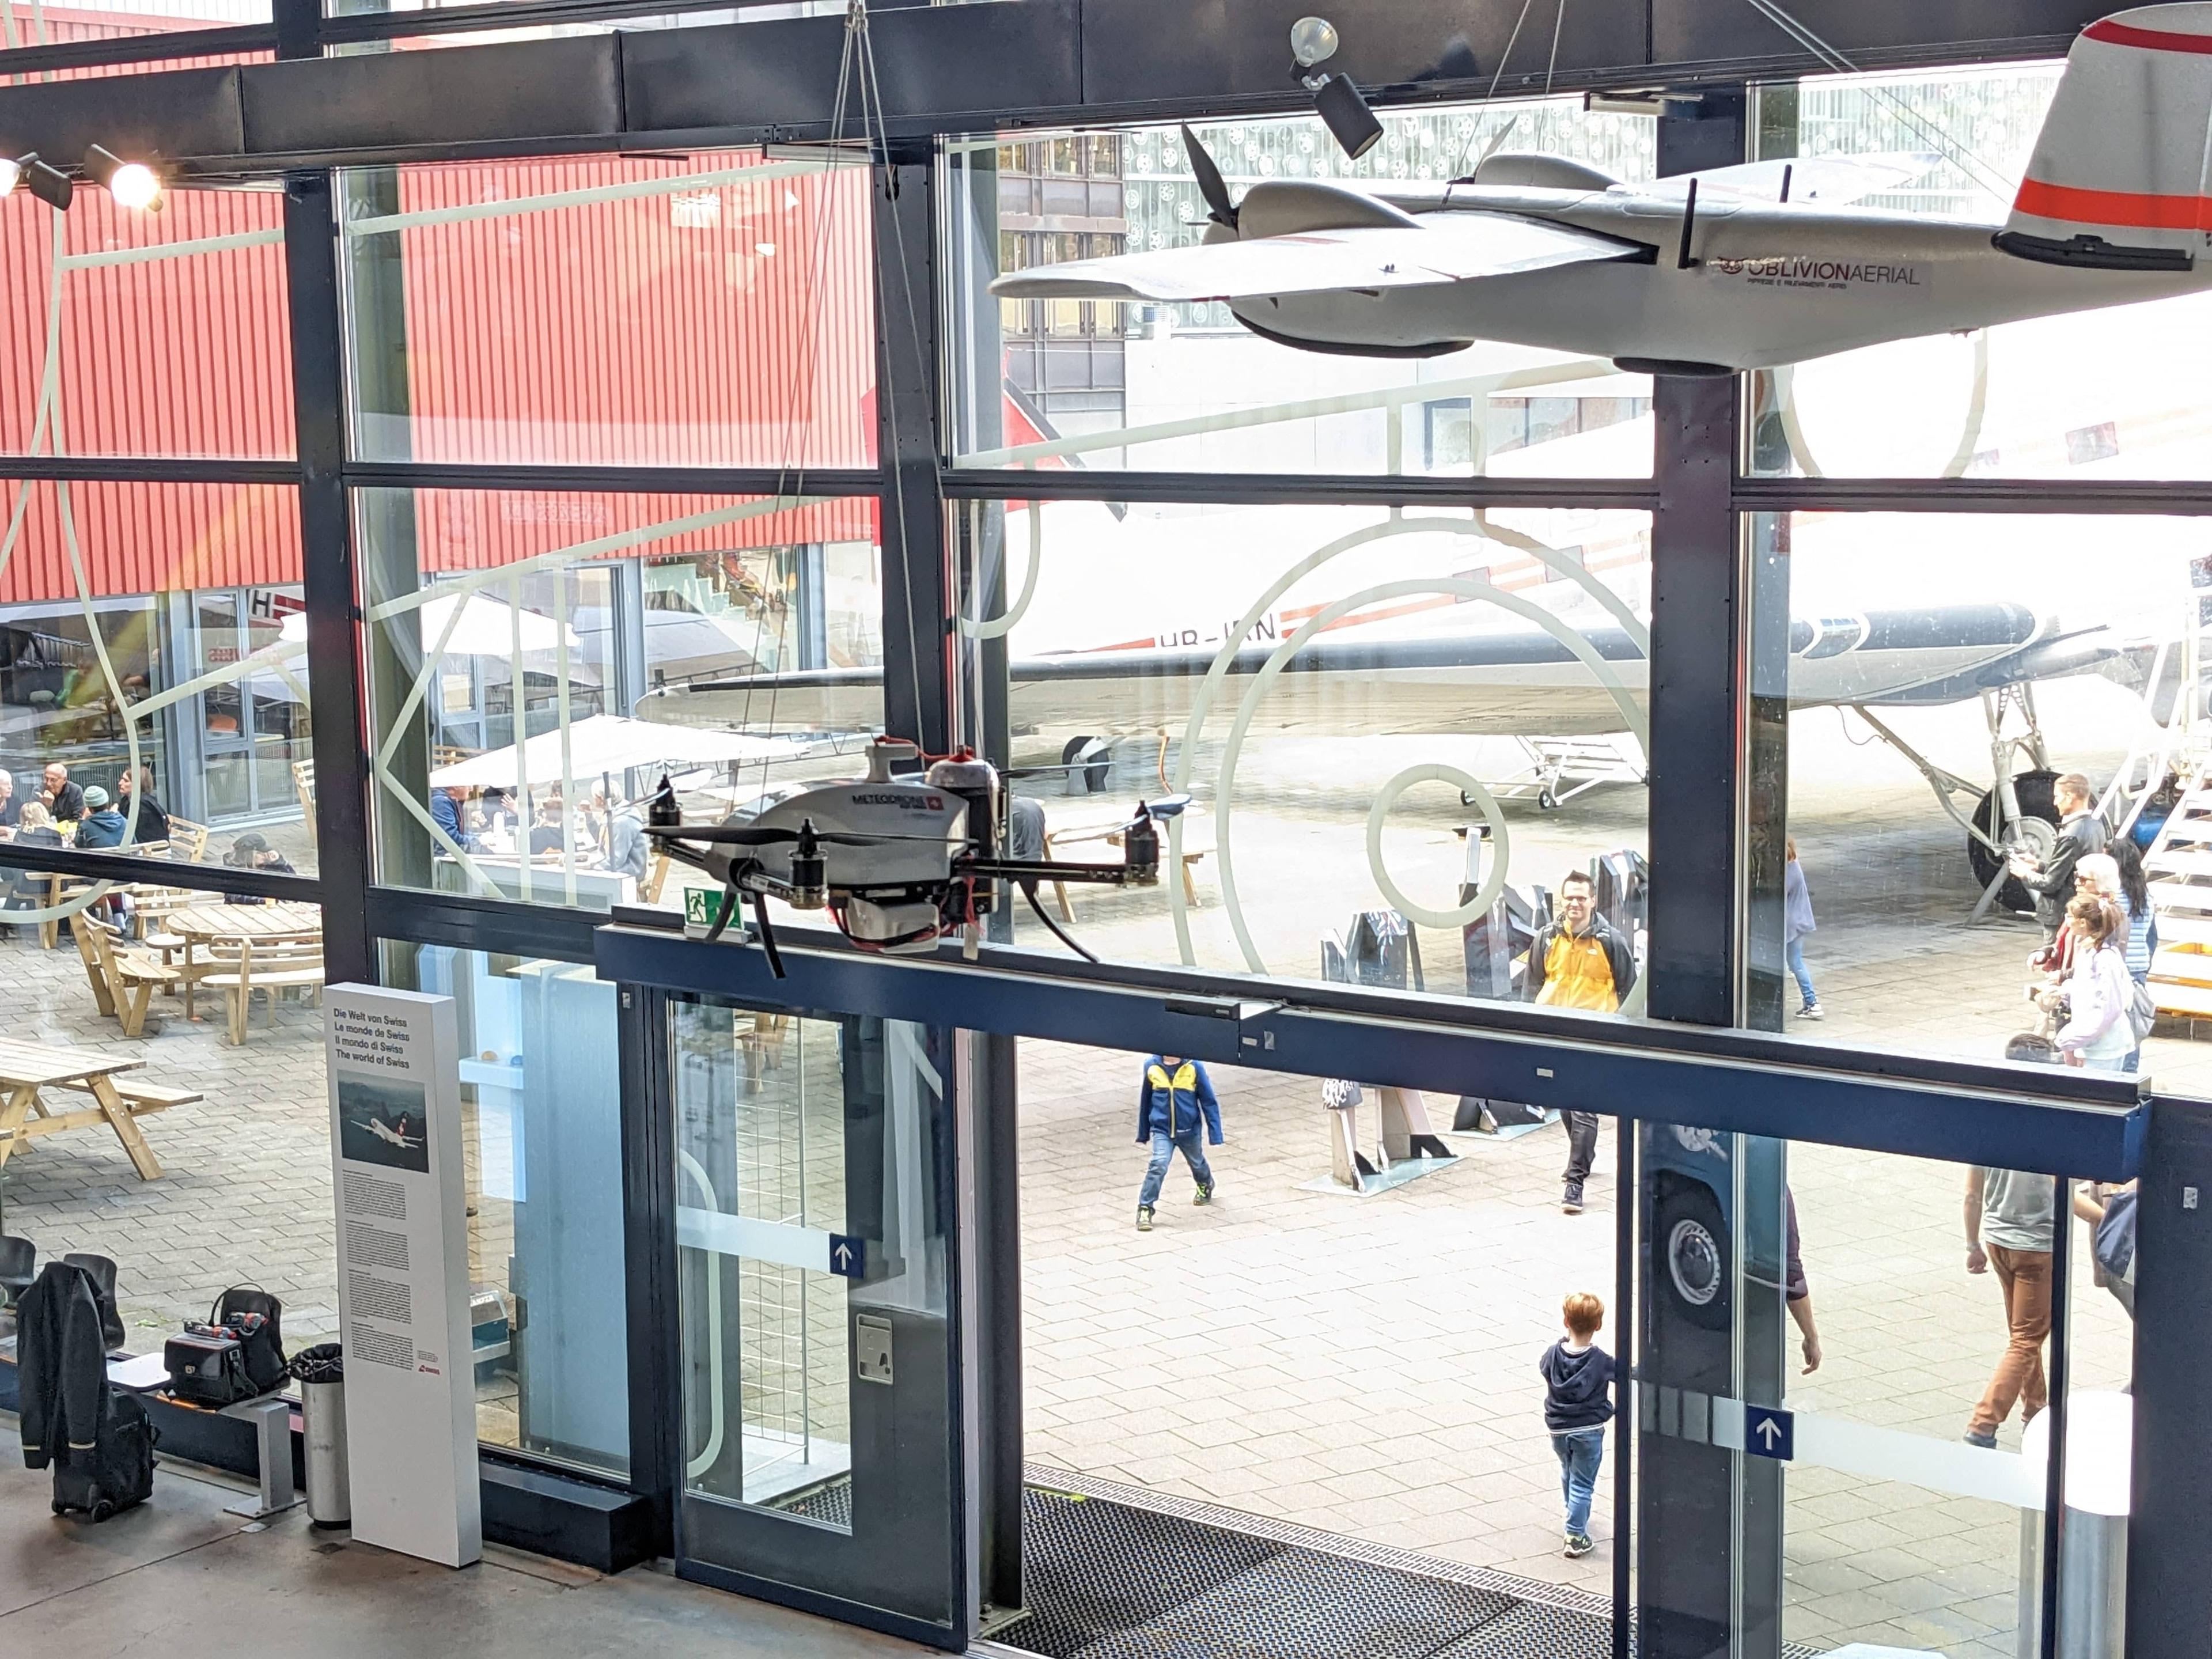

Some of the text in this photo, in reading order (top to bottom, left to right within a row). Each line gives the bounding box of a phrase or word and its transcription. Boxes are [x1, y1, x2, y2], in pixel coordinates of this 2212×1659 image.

[1748, 260, 1920, 285] OBLIVIONAERIAL
[334, 1008, 407, 1027] Die Welt von Swiss
[334, 1021, 410, 1041] Le monde de Swiss
[335, 1035, 403, 1054] Il mondo di Swiss
[336, 1049, 410, 1069] The world of Swiss
